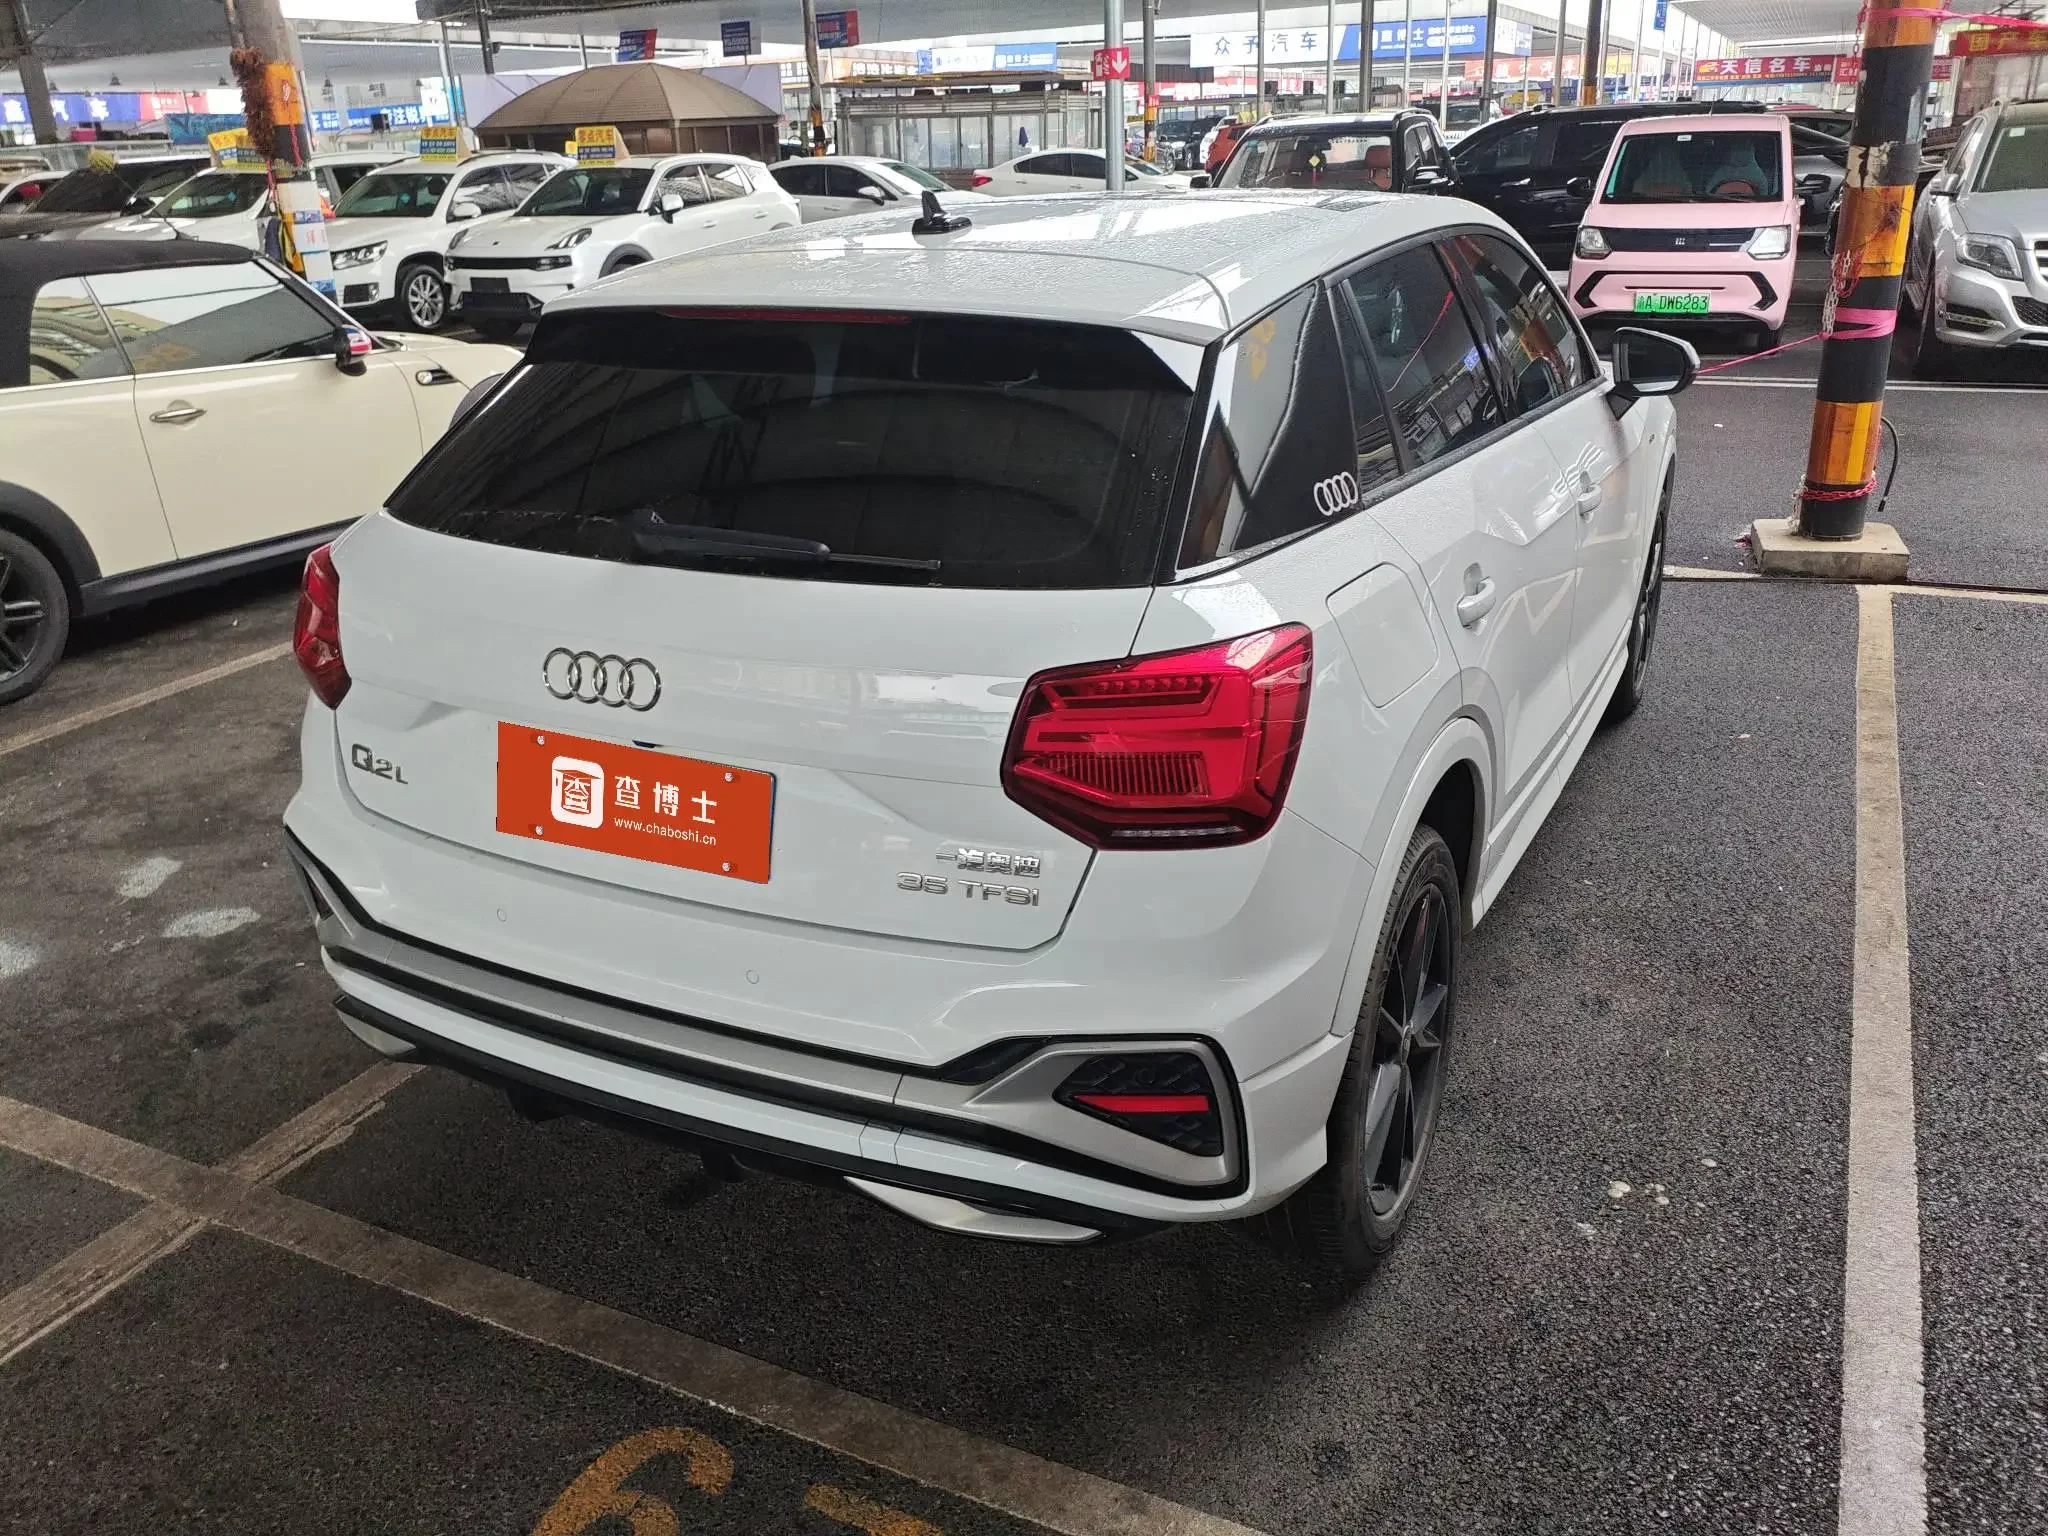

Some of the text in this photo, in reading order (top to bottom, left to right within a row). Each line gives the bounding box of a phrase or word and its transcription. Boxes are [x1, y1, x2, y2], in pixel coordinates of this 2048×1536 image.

[1214, 31, 1318, 56] 众予汽车
[1719, 57, 1812, 75] 天信名车
[352, 743, 409, 785] Q2L
[896, 871, 1040, 907] 35 TFSI
